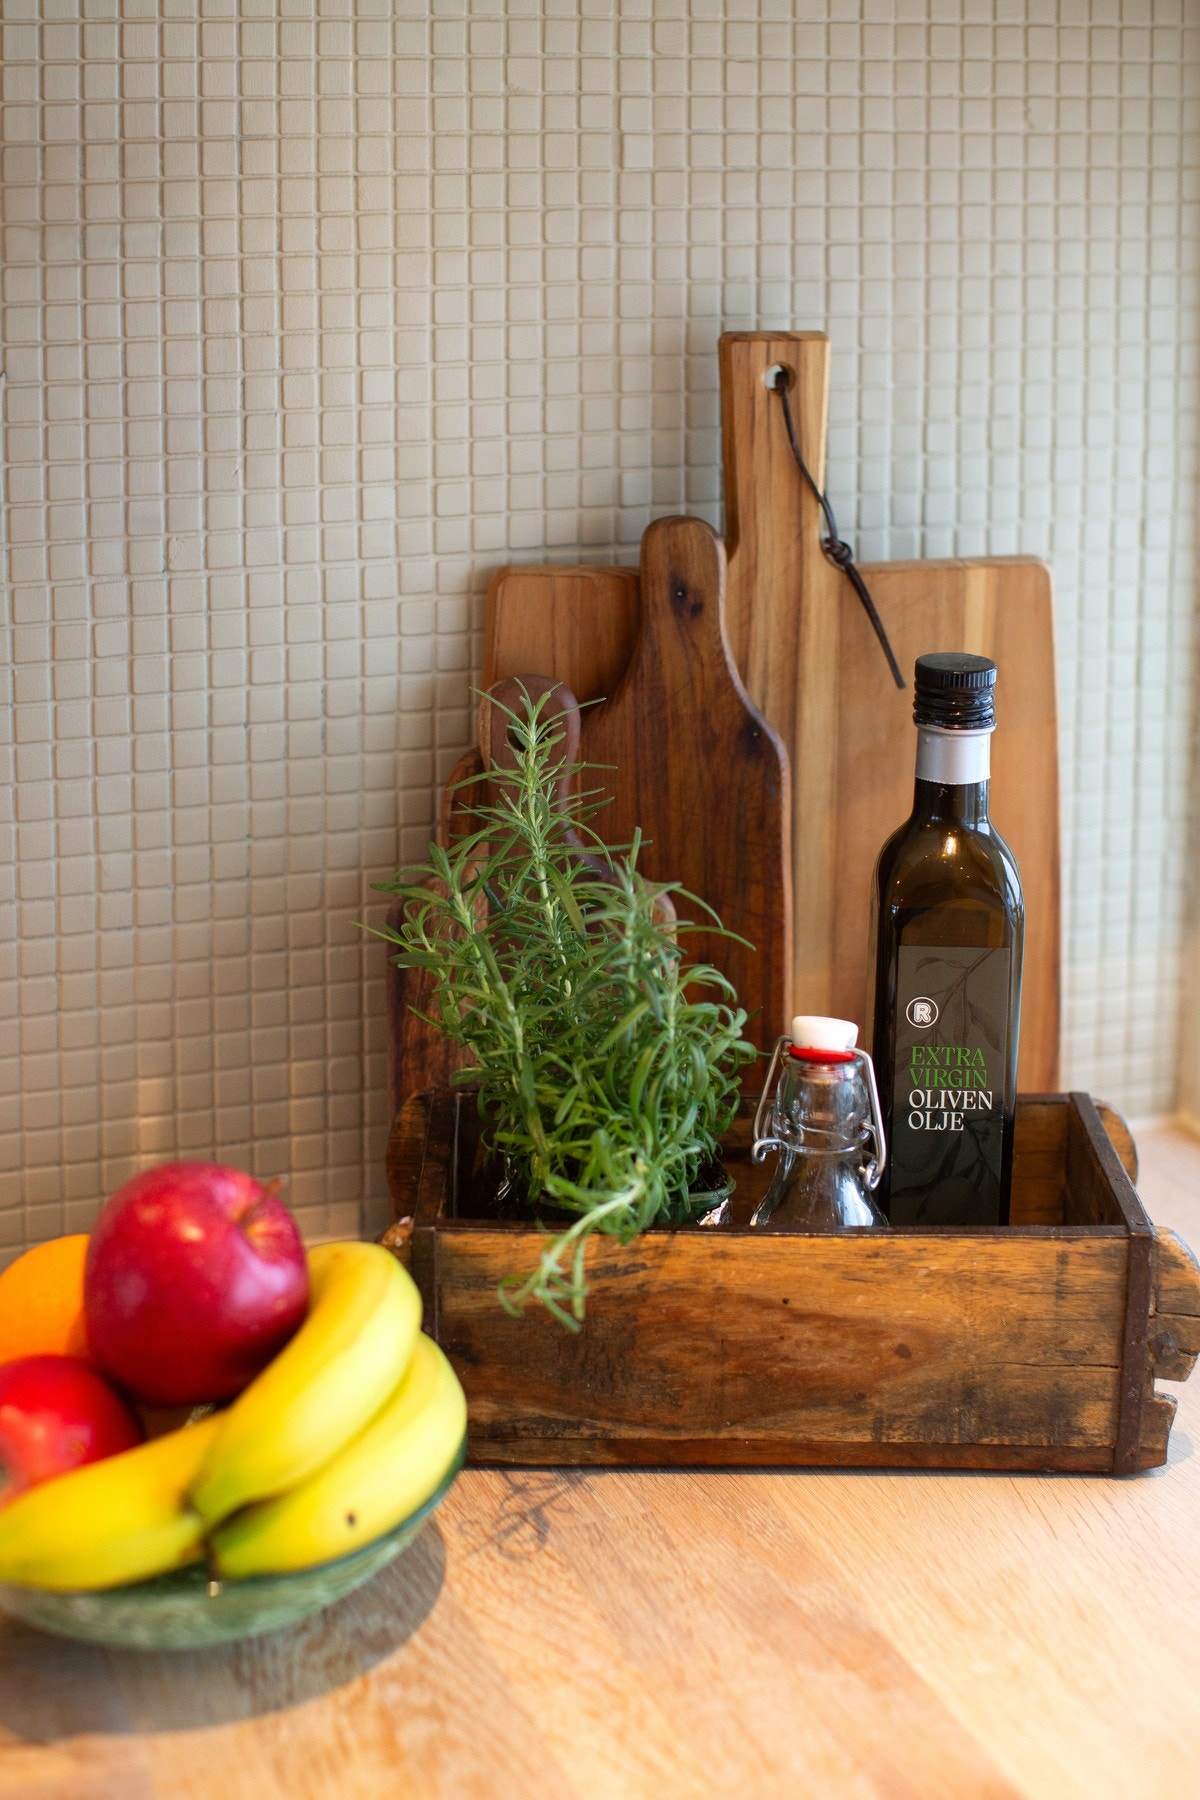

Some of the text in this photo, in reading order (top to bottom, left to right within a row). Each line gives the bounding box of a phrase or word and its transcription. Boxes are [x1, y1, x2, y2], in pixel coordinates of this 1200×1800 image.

[911, 1046, 986, 1067] EXTRA
[909, 1067, 987, 1088] VIRGIN
[908, 1089, 993, 1110] OLIVEN
[908, 1110, 964, 1131] OLJE
